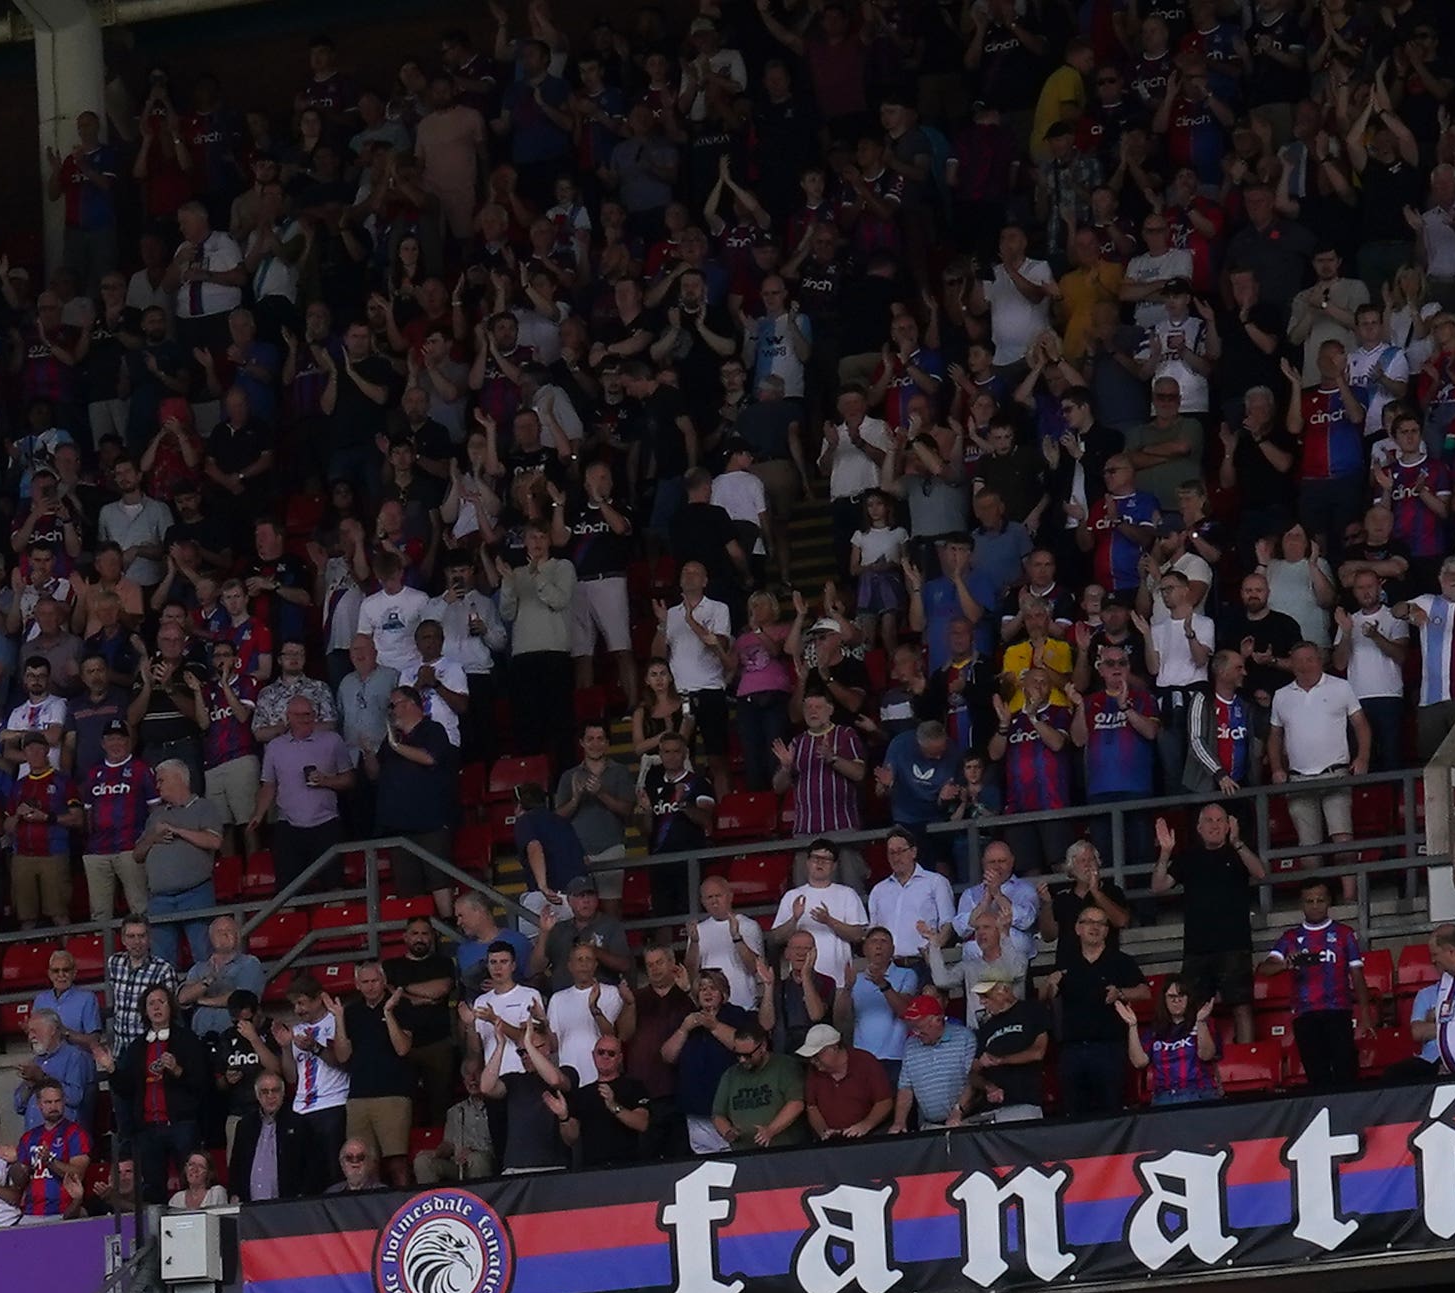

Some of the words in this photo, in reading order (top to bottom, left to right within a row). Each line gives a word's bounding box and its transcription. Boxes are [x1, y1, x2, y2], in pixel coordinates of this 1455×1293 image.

[984, 39, 1019, 53] cinch
[1176, 115, 1210, 127] cinch
[1392, 486, 1419, 500] cinc
[573, 522, 609, 534] cinch
[211, 707, 232, 721] cinc
[92, 783, 130, 795] cinch
[653, 800, 680, 814] cinc
[1164, 1037, 1193, 1050] TDK
[739, 1084, 772, 1099] STAR
[733, 1095, 770, 1110] WARS
[382, 1198, 473, 1262] holmesdale
